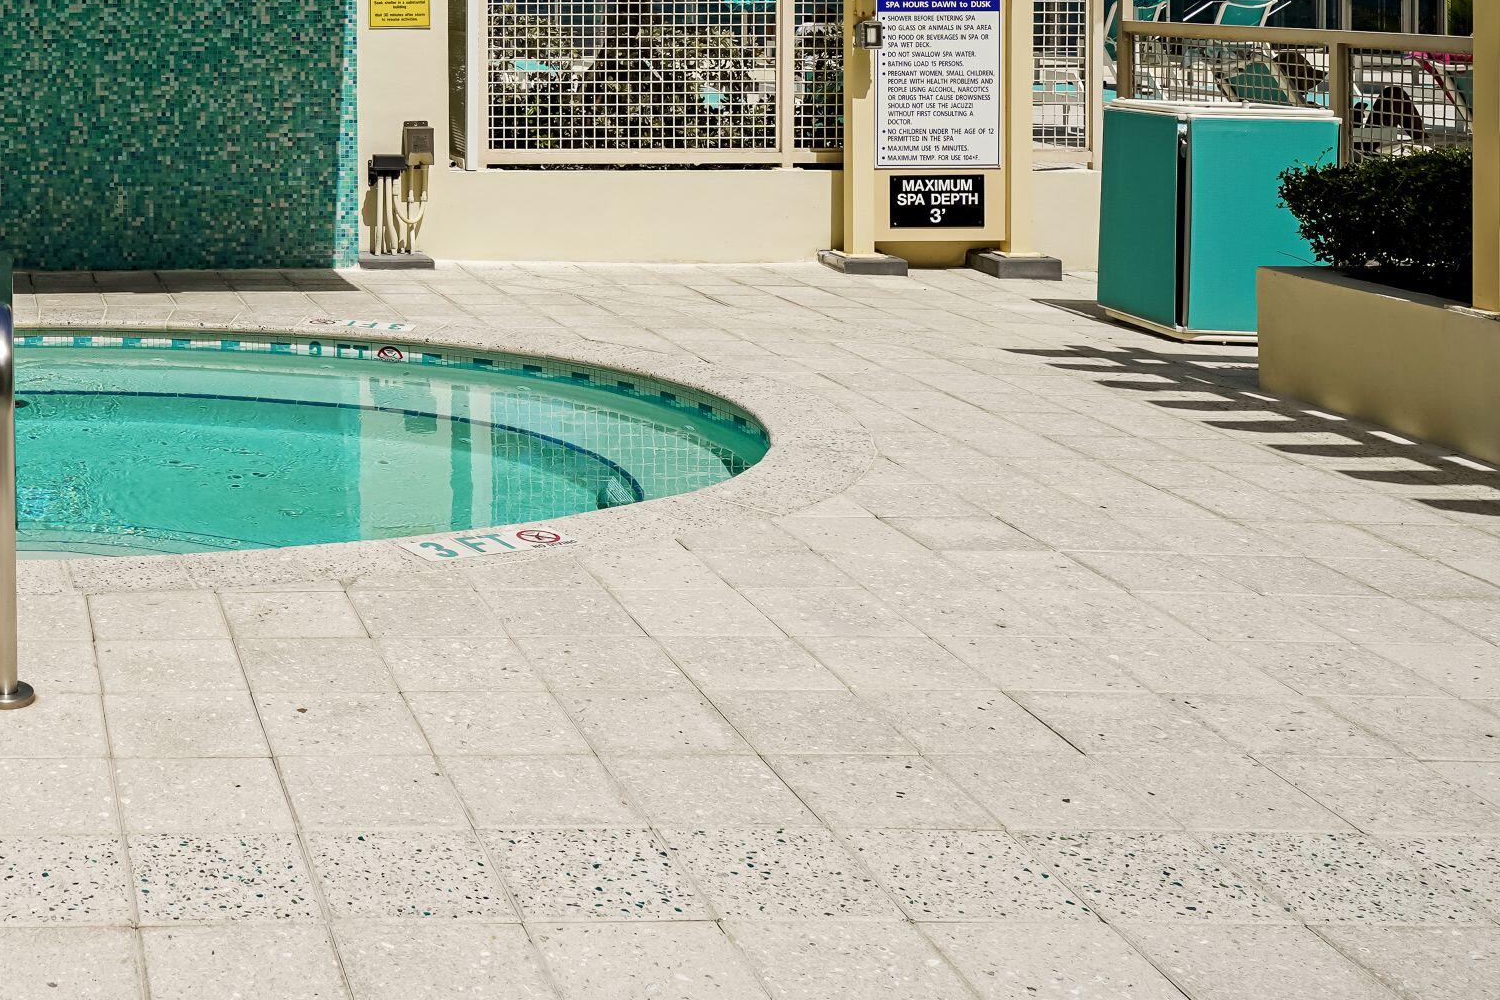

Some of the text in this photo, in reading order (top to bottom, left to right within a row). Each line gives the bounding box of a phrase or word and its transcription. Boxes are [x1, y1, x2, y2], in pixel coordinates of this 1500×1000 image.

[902, 179, 972, 191] MAXIMUM
[897, 193, 978, 205] SPA DEPTH
[930, 208, 946, 223] 3'
[420, 533, 517, 558] 3 FT
